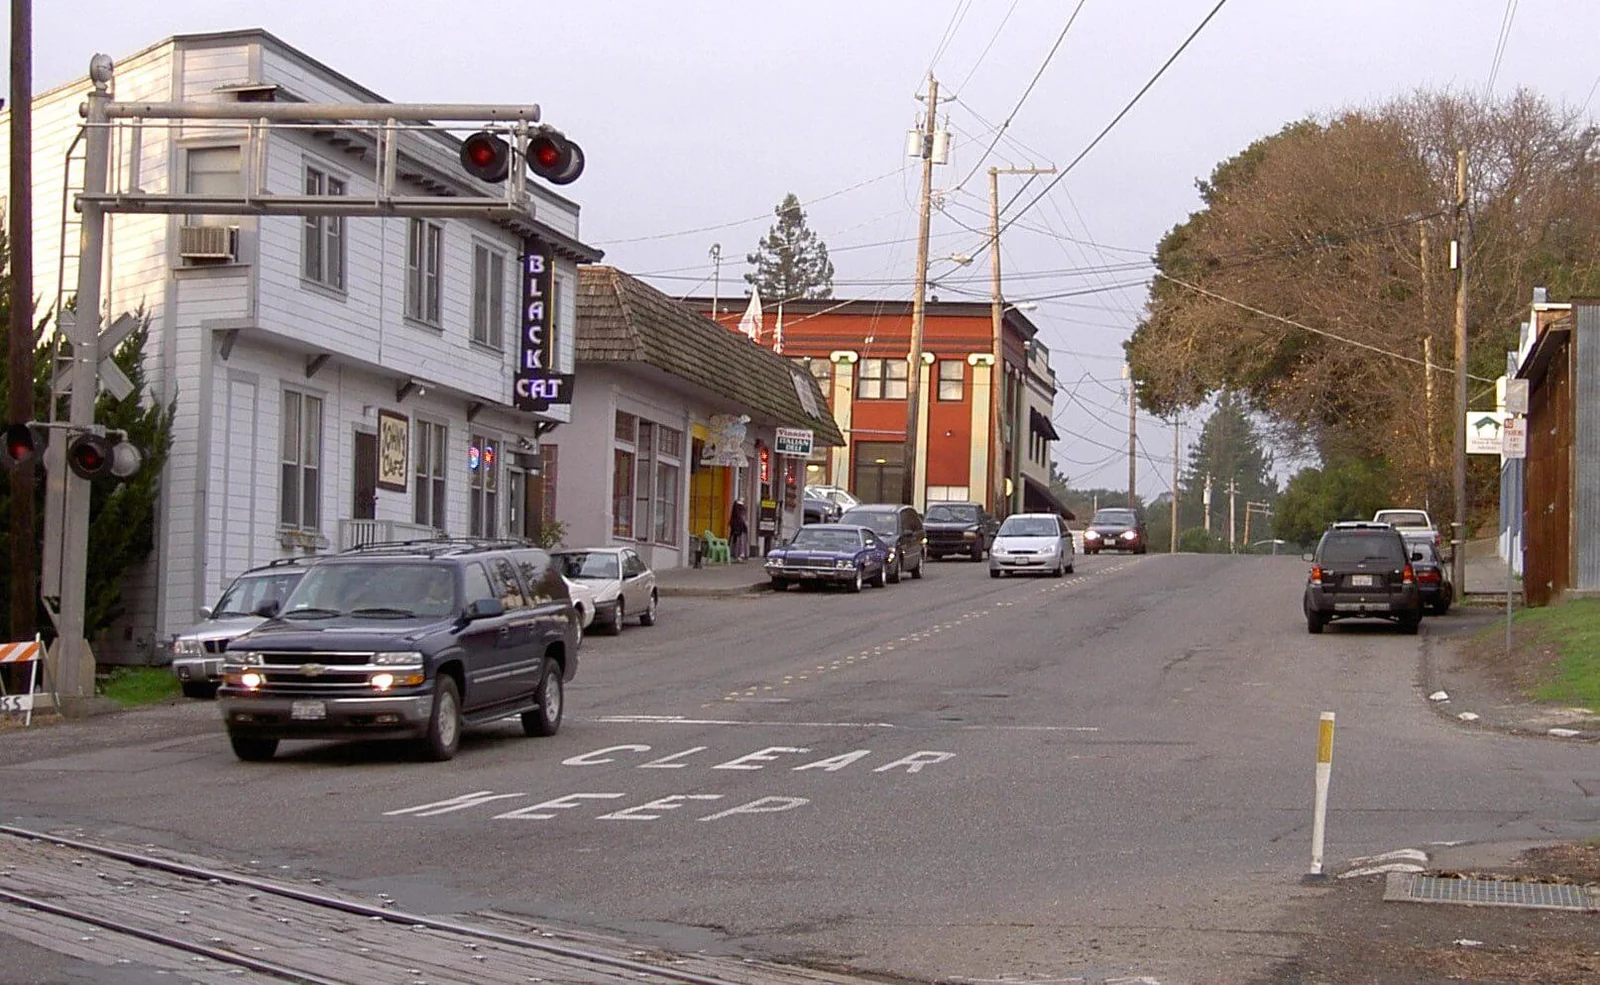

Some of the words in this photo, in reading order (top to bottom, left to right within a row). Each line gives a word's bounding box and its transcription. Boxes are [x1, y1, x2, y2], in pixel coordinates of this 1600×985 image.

[526, 254, 545, 369] BLACK
[516, 379, 563, 399] CAT
[779, 437, 809, 446] ITALIAN
[561, 744, 957, 773] CLEAR
[381, 790, 811, 821] KEEP
